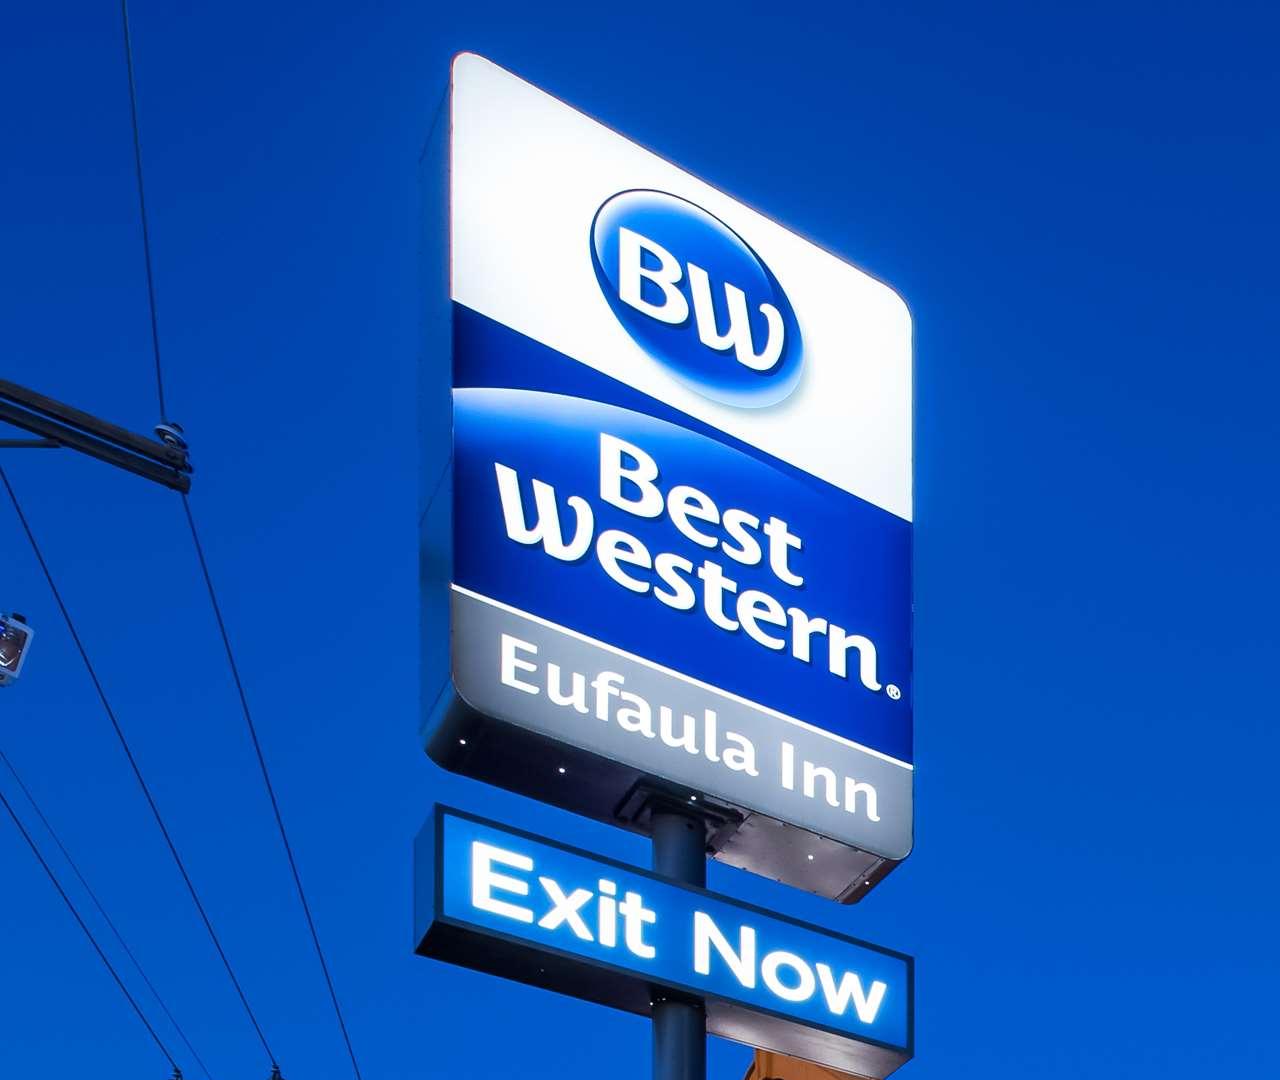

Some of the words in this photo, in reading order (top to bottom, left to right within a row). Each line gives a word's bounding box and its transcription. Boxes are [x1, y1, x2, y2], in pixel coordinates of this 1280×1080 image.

[618, 226, 785, 371] BW
[600, 432, 804, 587] Best
[501, 633, 760, 777] Eufaula
[780, 740, 881, 822] Inn
[471, 840, 657, 959] Exit
[693, 910, 888, 1025] Now
